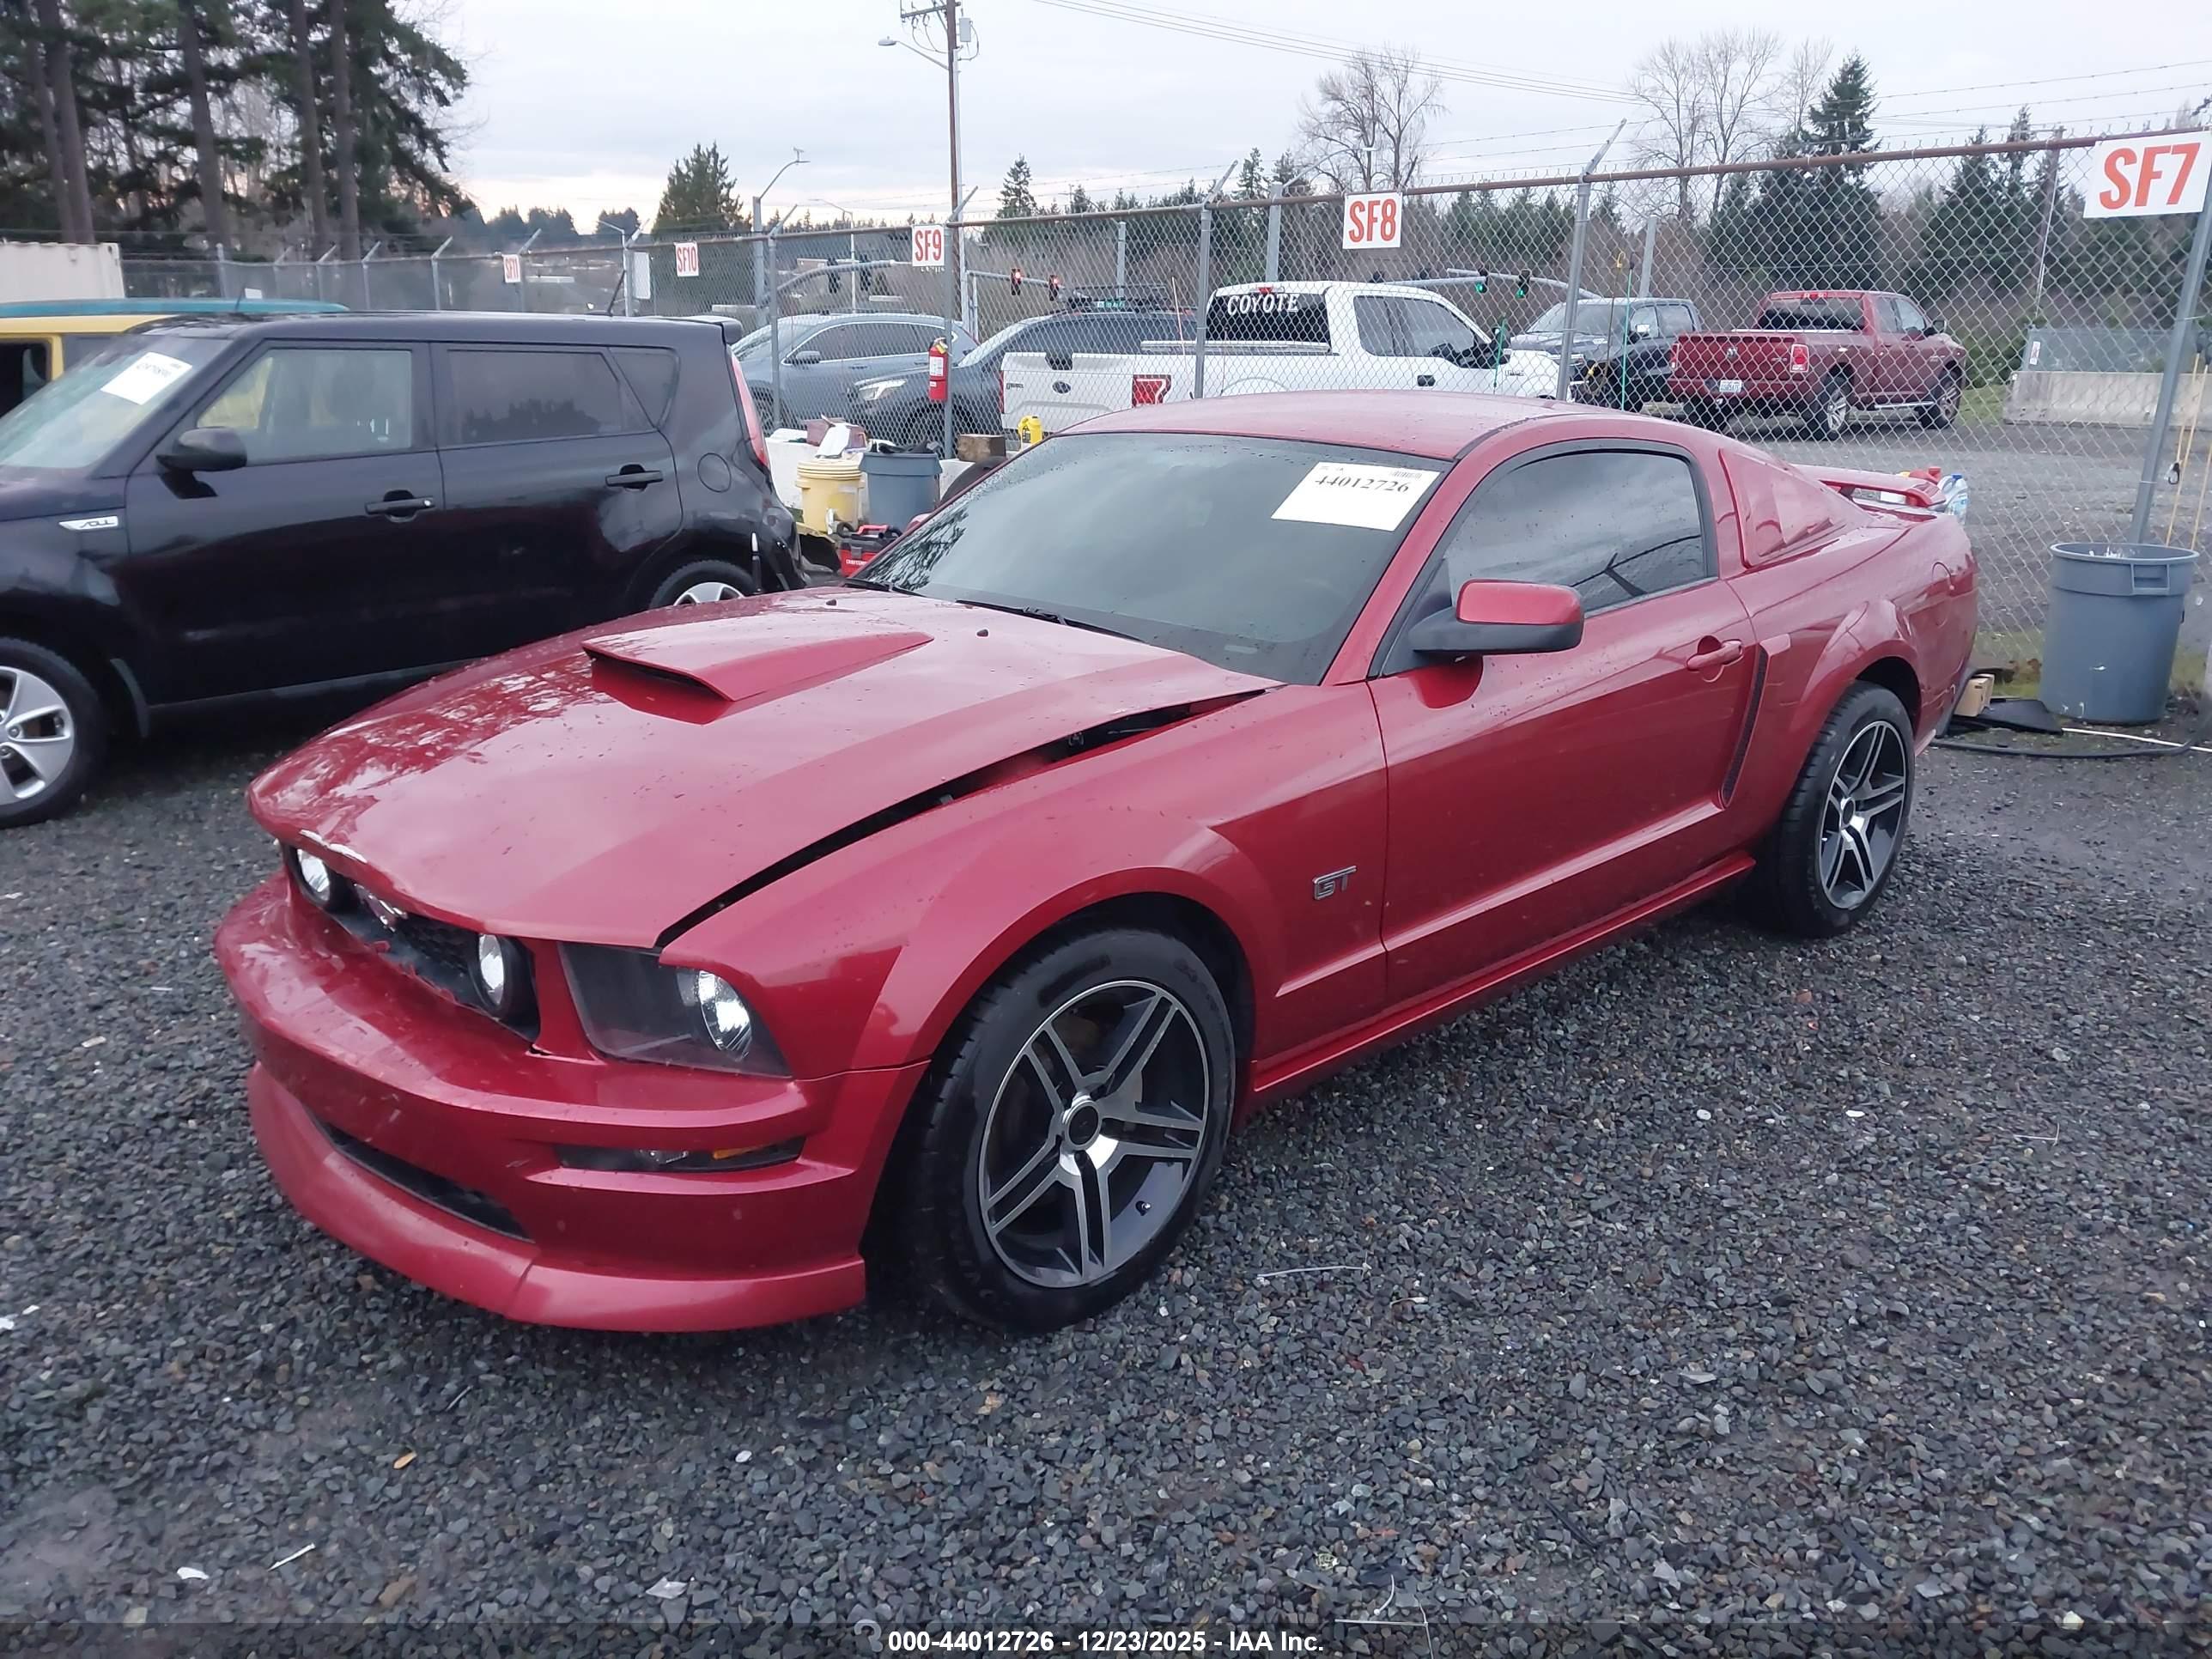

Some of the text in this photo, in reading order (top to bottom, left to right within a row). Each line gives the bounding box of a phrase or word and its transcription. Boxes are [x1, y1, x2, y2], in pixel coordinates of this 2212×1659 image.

[2099, 143, 2201, 210] SF7
[1349, 198, 1397, 243] SF8
[677, 246, 697, 273] SF10
[915, 228, 942, 262] SF9
[1227, 293, 1301, 316] COYOTE
[1315, 476, 1411, 493] 44012726
[1314, 865, 1357, 900] GT
